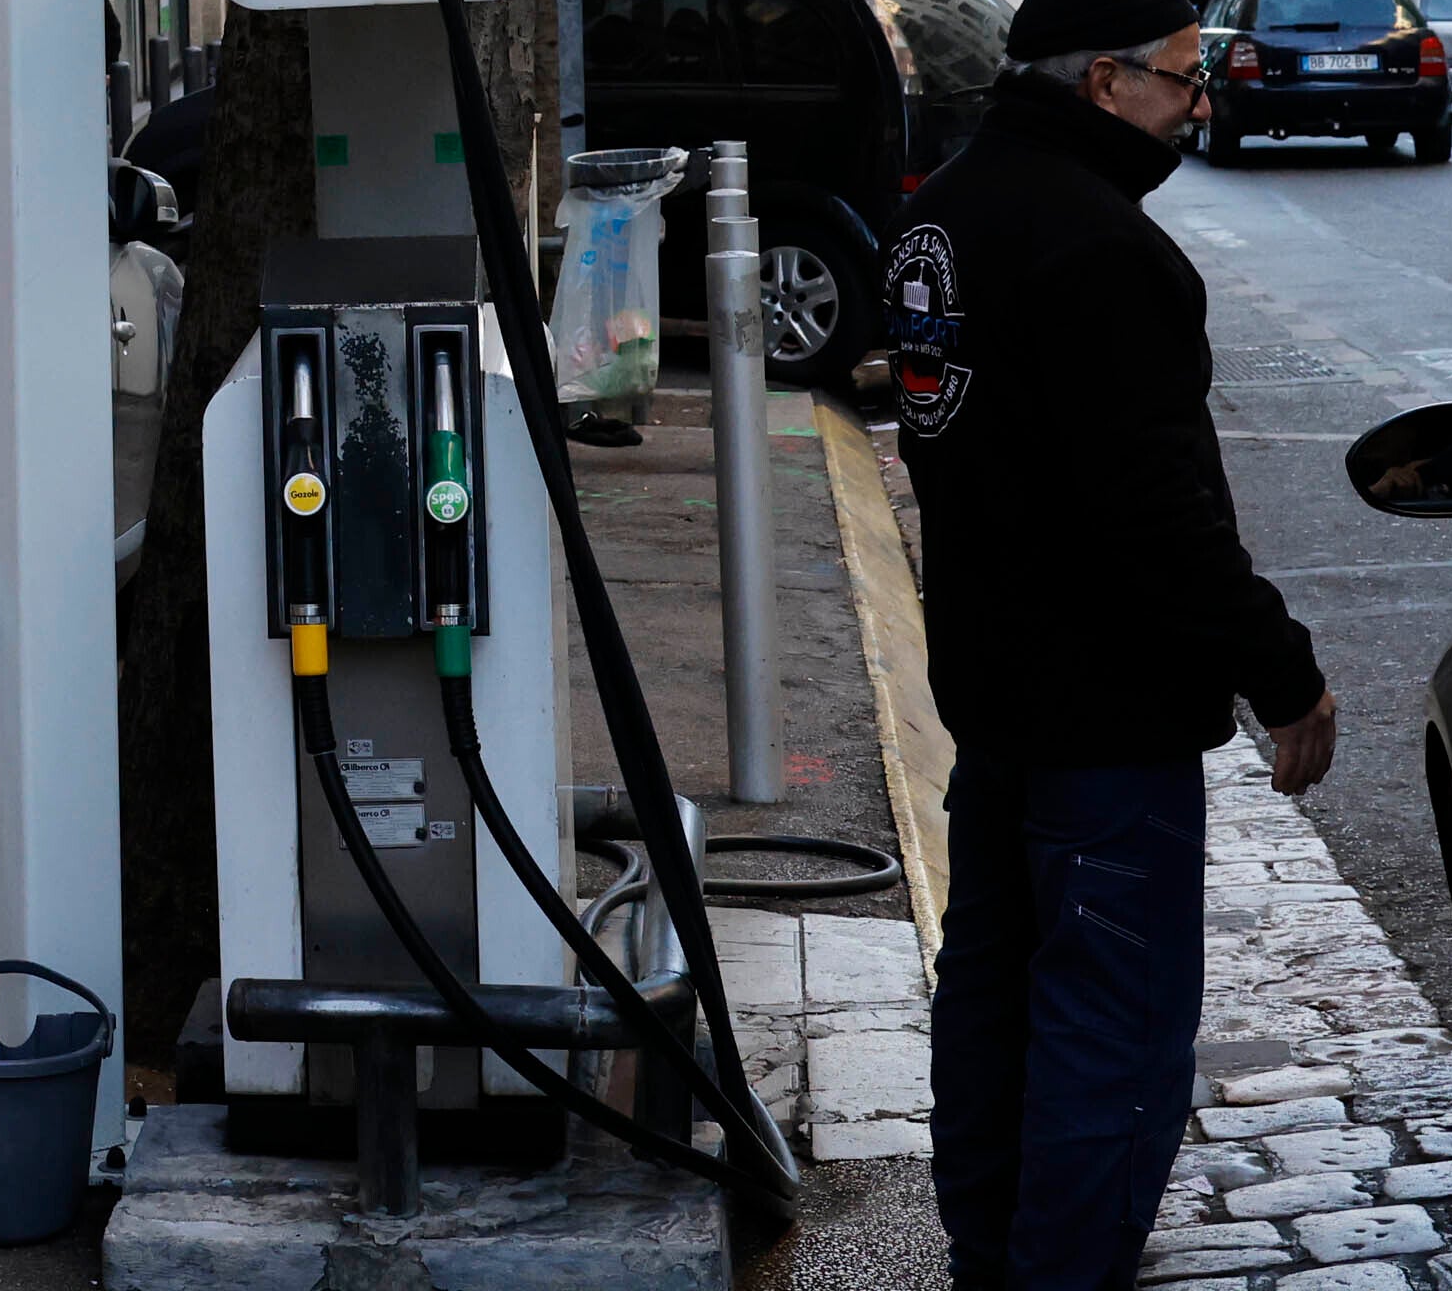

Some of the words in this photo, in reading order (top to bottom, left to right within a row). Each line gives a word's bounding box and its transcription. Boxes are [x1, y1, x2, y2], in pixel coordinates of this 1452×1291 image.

[928, 236, 955, 305] SHIPPING
[290, 490, 319, 499] Gazole
[431, 492, 462, 505] SP95
